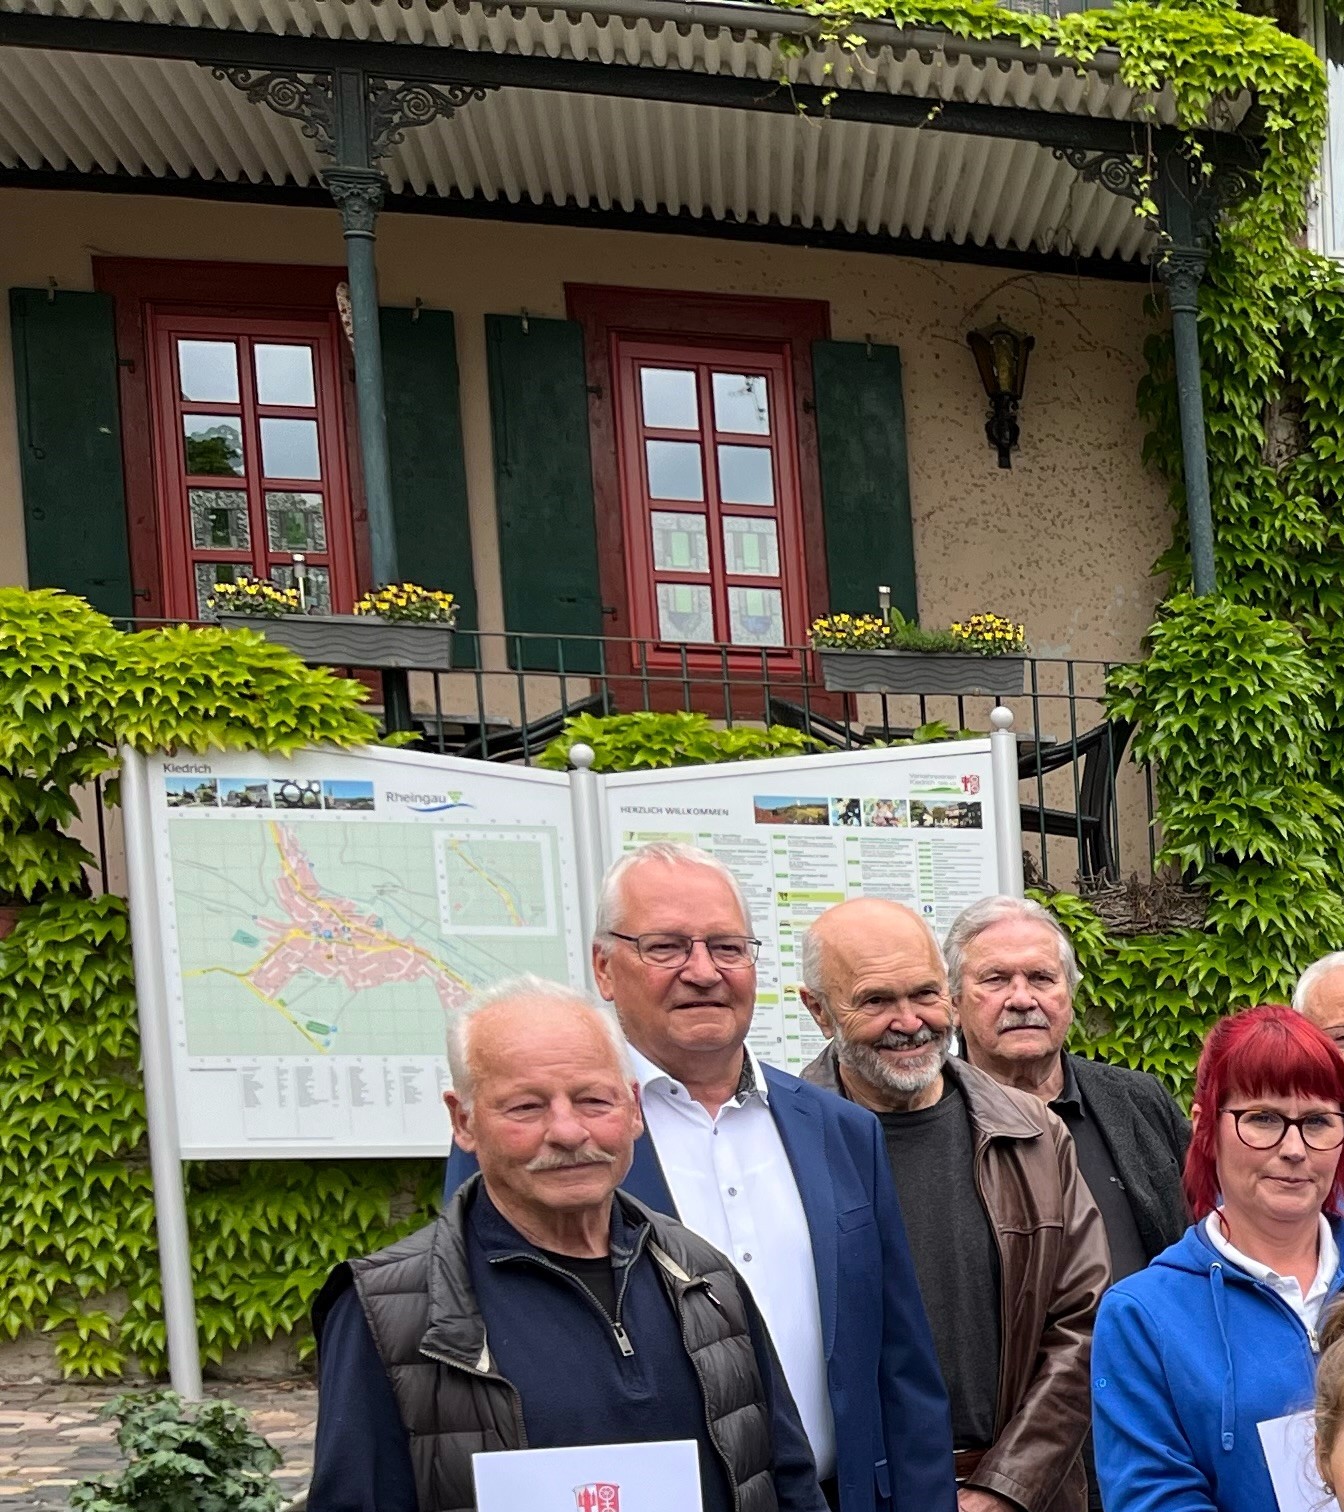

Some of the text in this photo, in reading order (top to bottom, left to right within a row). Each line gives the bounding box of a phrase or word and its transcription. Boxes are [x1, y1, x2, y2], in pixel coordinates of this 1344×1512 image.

[163, 763, 211, 774] Kiedrich
[385, 791, 447, 805] Rheingau
[620, 806, 729, 816] HERZLICH WILLKOMMEN
